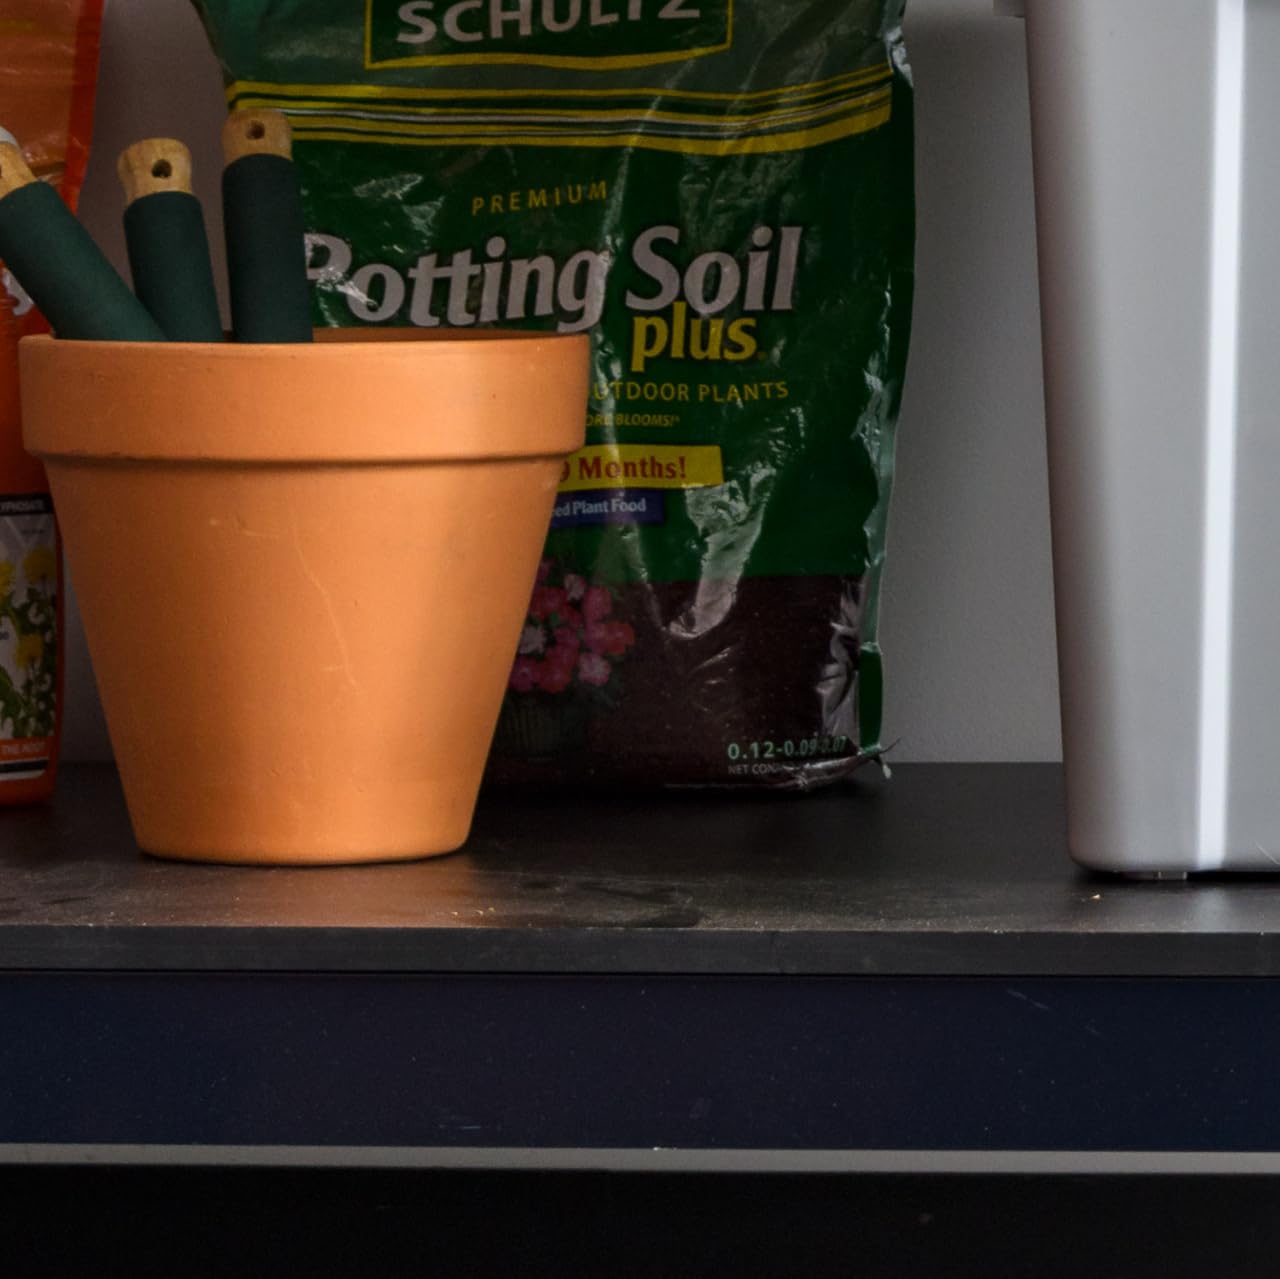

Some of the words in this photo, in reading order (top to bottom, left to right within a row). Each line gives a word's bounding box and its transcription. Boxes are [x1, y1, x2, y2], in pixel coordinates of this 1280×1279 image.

[471, 181, 608, 216] PREMIUM
[303, 232, 612, 333] Potting
[626, 225, 803, 316] Soil
[631, 301, 758, 373] plus
[588, 382, 689, 401] UTDOOR
[698, 381, 789, 403] PLANTS
[578, 455, 687, 481] Months!
[572, 499, 608, 516] Plant
[611, 497, 647, 514] Food
